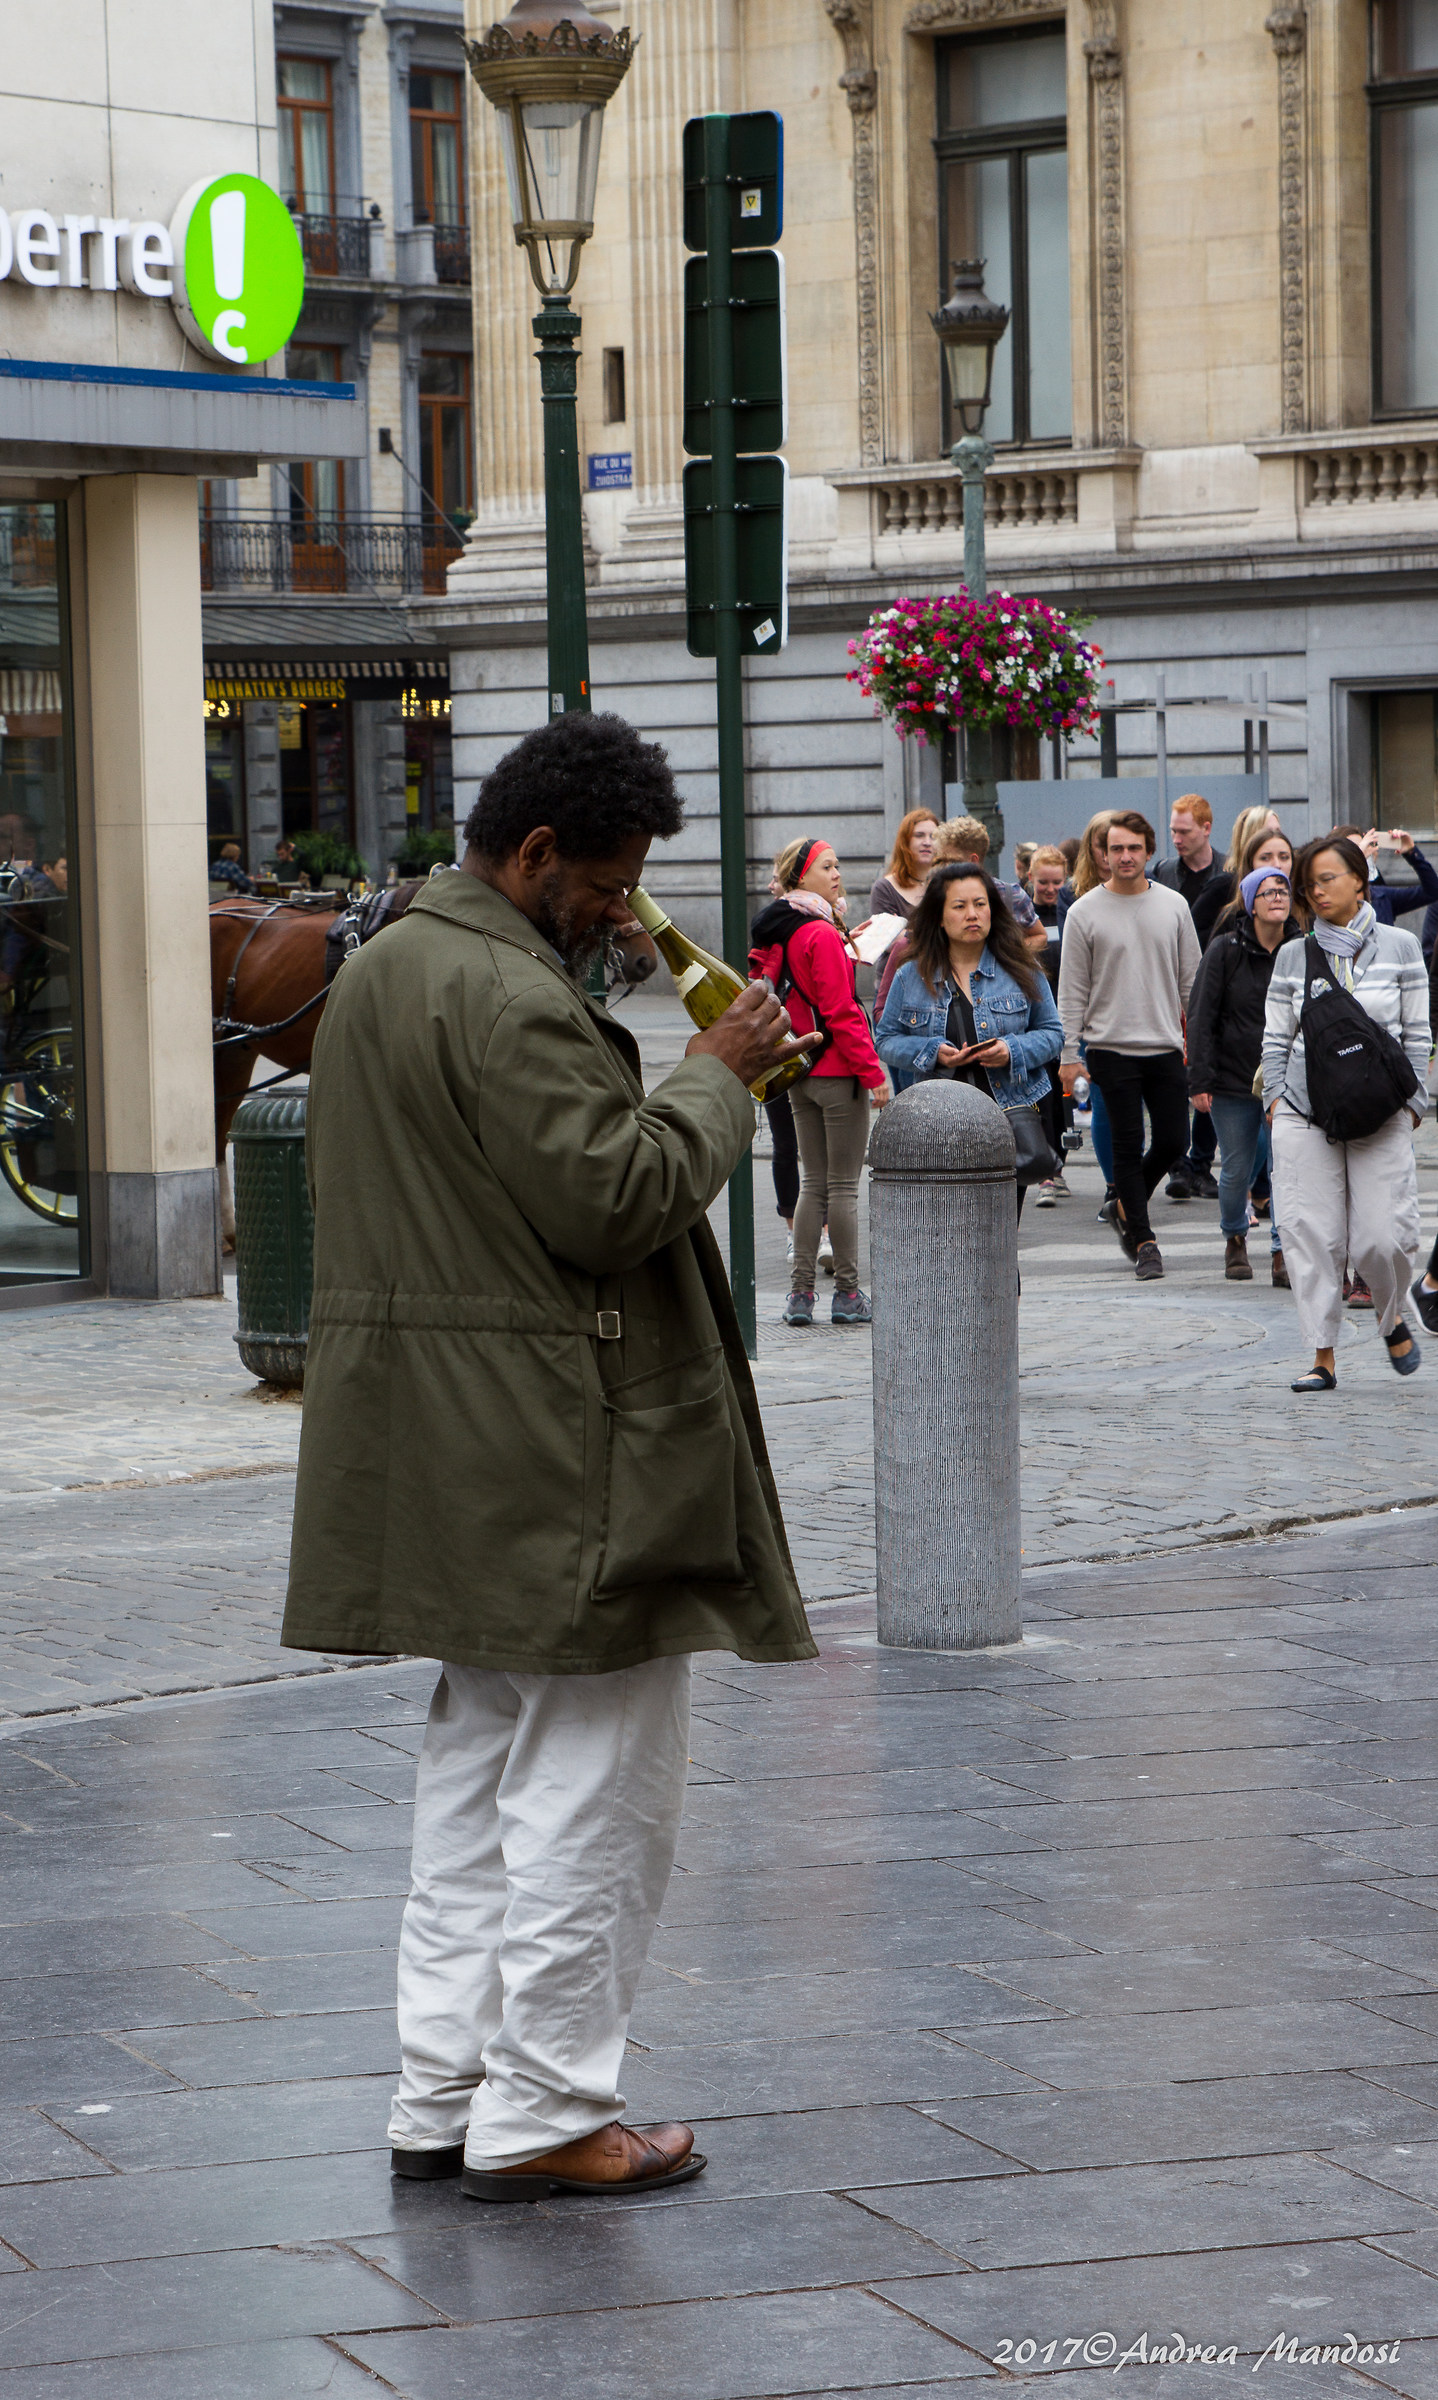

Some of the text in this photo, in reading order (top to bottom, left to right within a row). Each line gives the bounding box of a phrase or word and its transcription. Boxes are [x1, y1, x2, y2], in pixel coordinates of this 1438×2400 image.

[594, 459, 608, 469] RUE
[609, 457, 620, 468] DU
[205, 679, 346, 699] MANHATTN'S BURGERS
[1337, 1043, 1364, 1057] TRACKER
